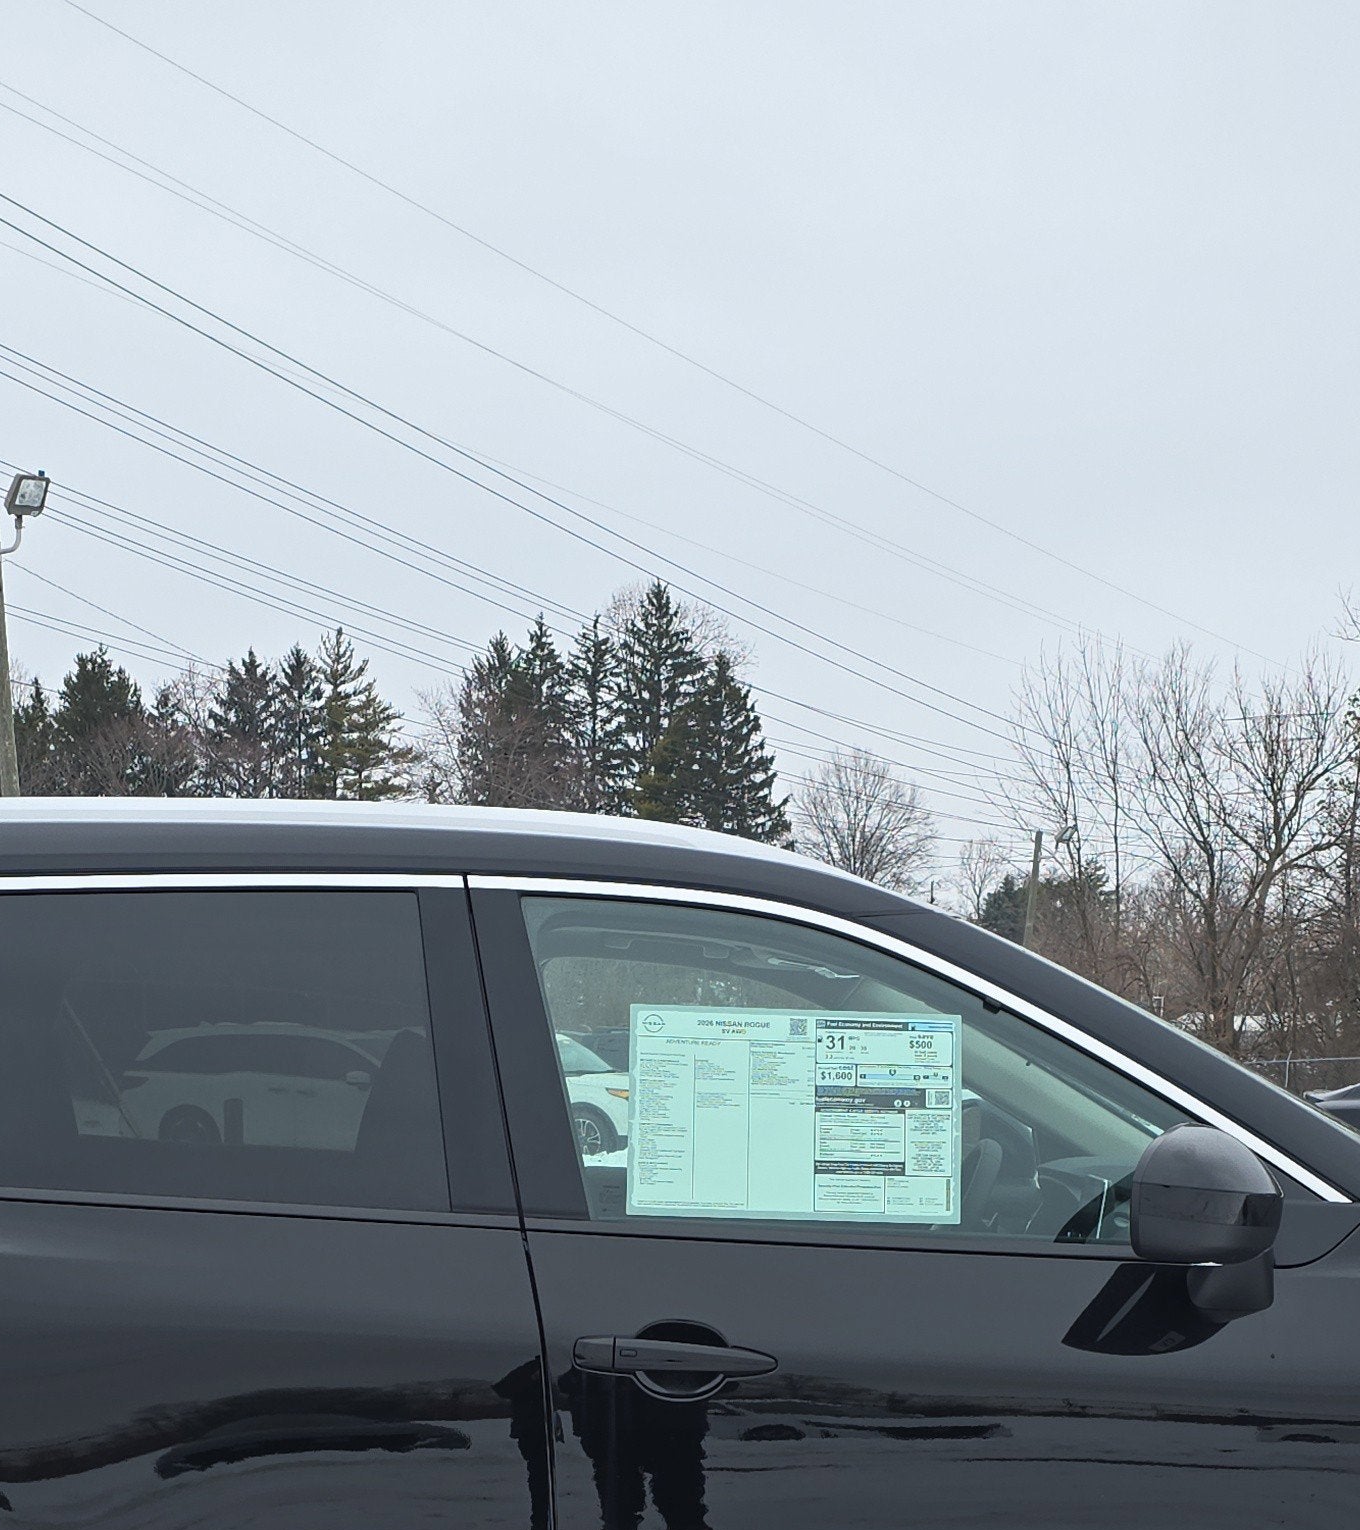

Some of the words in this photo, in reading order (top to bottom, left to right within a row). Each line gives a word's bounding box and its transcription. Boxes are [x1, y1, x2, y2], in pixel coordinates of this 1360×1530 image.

[715, 1020, 743, 1028] NISSAN
[744, 1021, 771, 1029] ROGUE
[826, 1035, 845, 1050] 31
[909, 1040, 933, 1050] $500
[821, 1071, 852, 1081] $1,600
